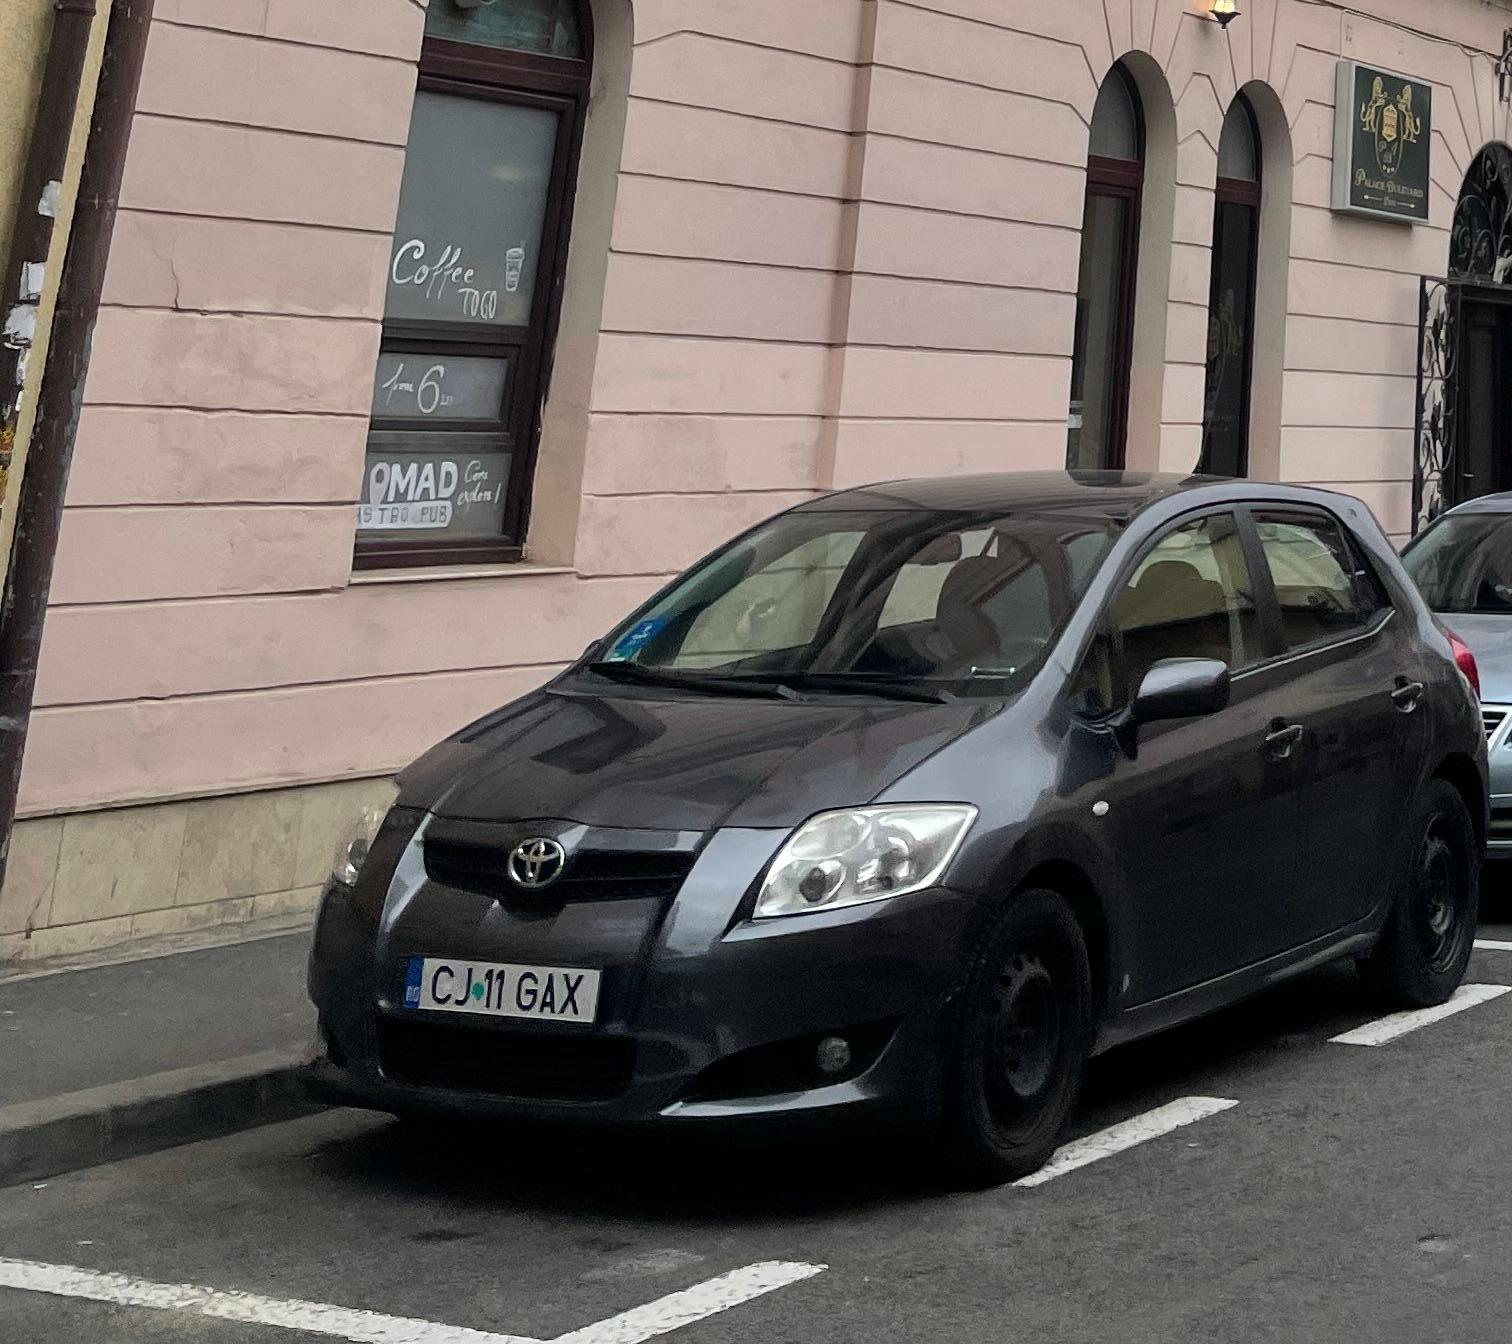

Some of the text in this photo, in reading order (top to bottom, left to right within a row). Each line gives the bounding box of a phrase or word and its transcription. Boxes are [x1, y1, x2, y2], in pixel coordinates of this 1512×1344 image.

[392, 239, 475, 300] Coffee
[417, 365, 445, 414] 6
[369, 461, 459, 506] OMAD
[420, 506, 447, 524] PUB
[431, 965, 585, 1016] CJ 11 GAX
